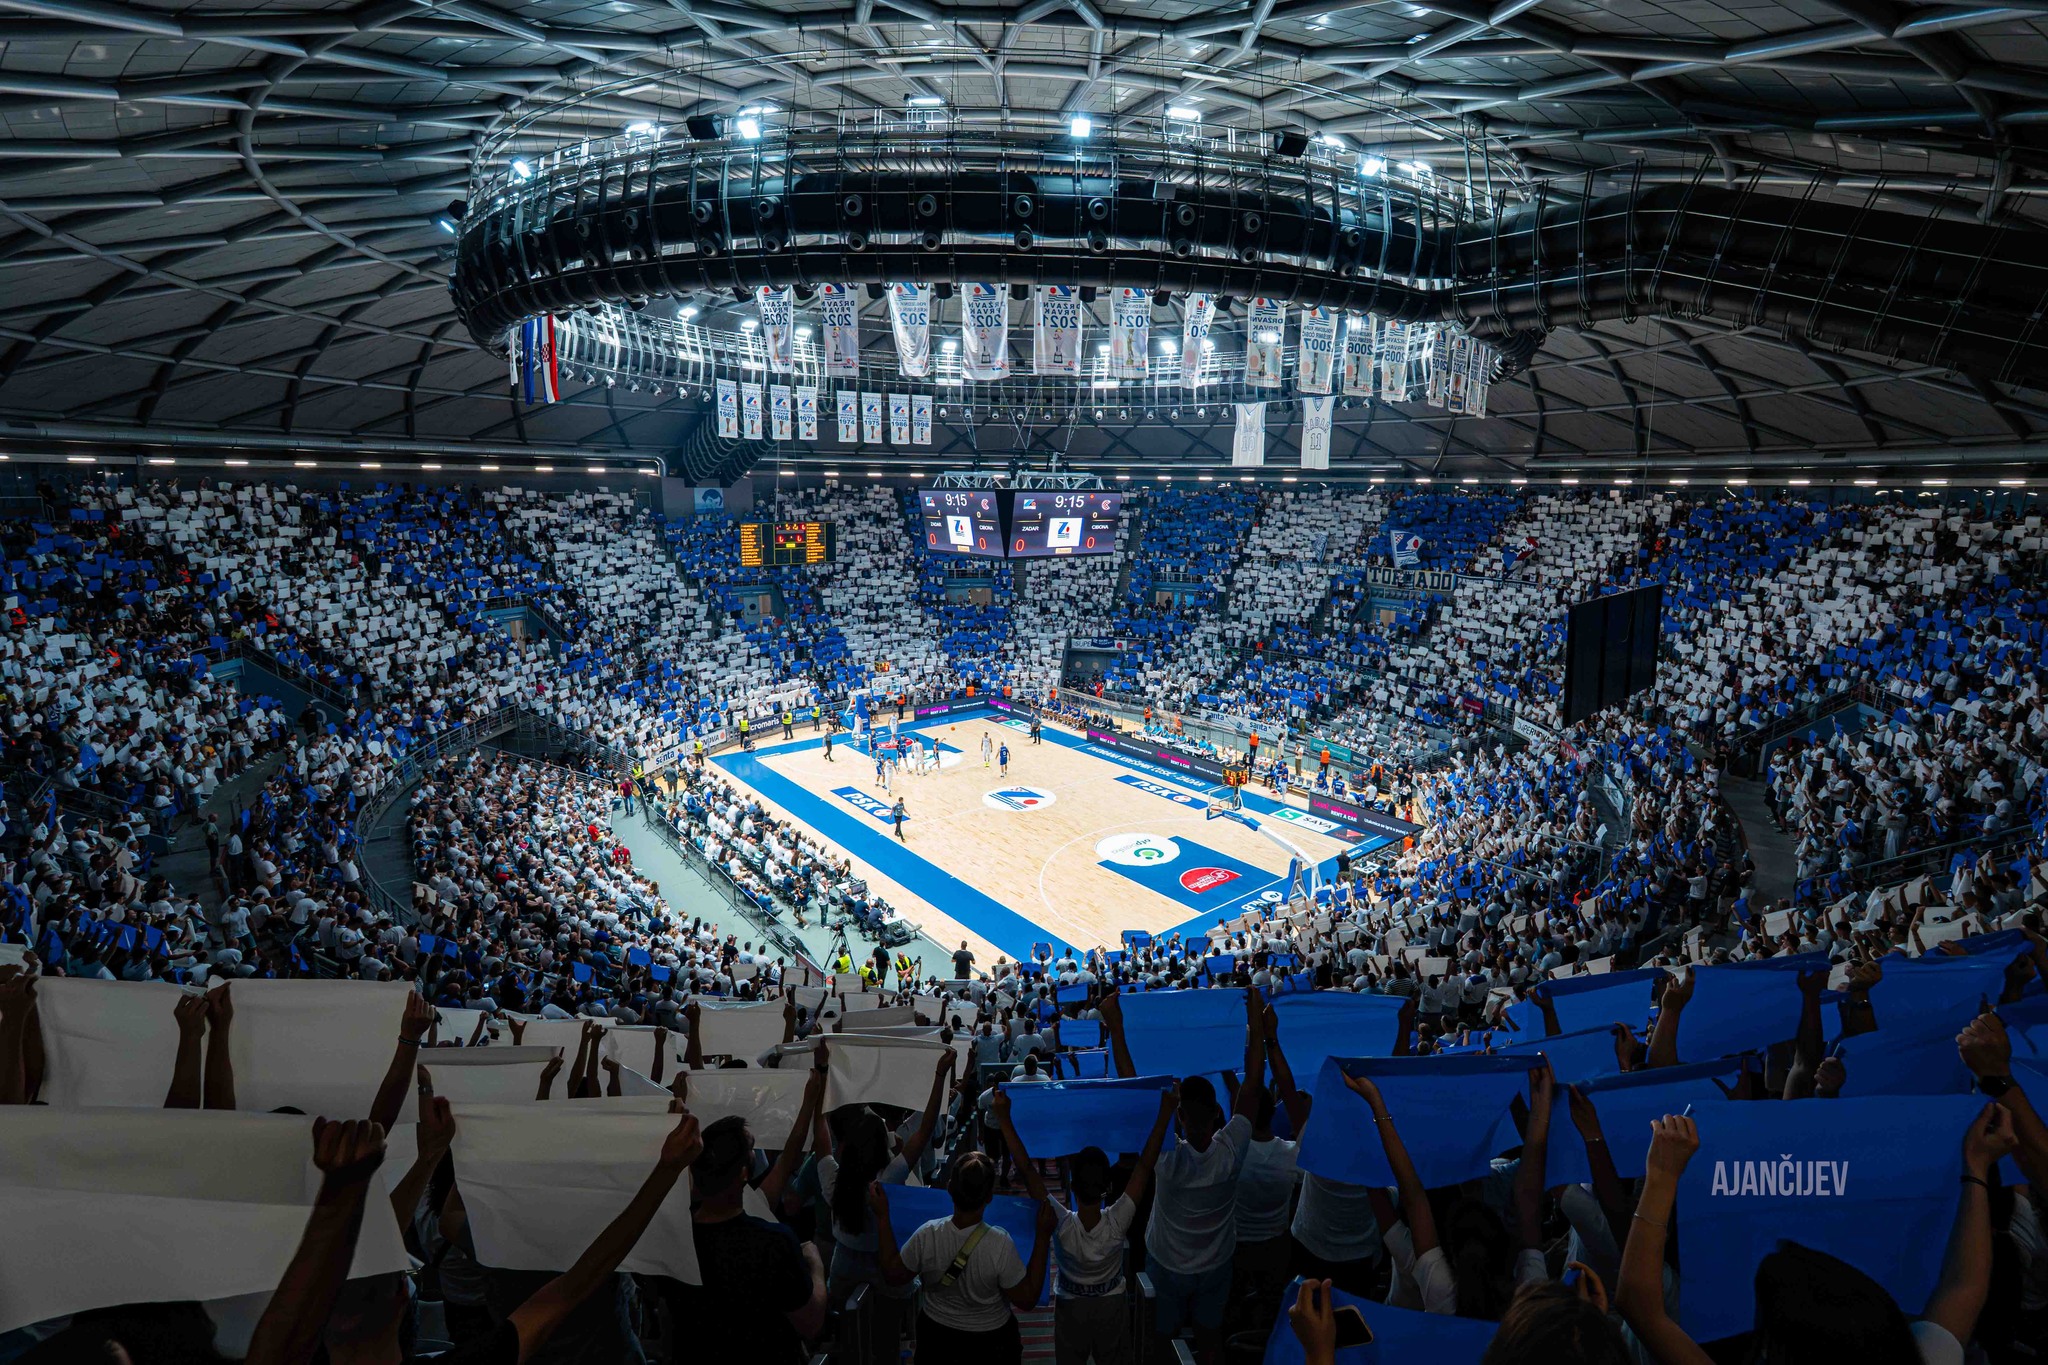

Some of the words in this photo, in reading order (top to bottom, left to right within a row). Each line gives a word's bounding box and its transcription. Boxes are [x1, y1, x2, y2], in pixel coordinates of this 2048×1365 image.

[1241, 436, 1256, 452] 10
[1310, 433, 1321, 450] 11
[946, 494, 967, 506] 9:15
[1056, 495, 1084, 508] 9:15
[929, 533, 937, 545] 0
[979, 537, 987, 550] 0
[1016, 539, 1025, 552] 0
[1087, 537, 1095, 549] 0
[1370, 566, 1452, 591] TORADO
[750, 718, 780, 732] cromaris
[1250, 721, 1268, 732] santa
[687, 735, 720, 750] SUNOVA
[1087, 746, 1121, 760] DVORANA
[1176, 776, 1206, 787] ZADAR
[1129, 781, 1177, 797] PSK
[843, 793, 880, 811] PSK
[1312, 800, 1330, 811] Last
[1331, 810, 1341, 818] RENT
[1303, 817, 1332, 830] SAVA
[1241, 898, 1268, 911] NLB
